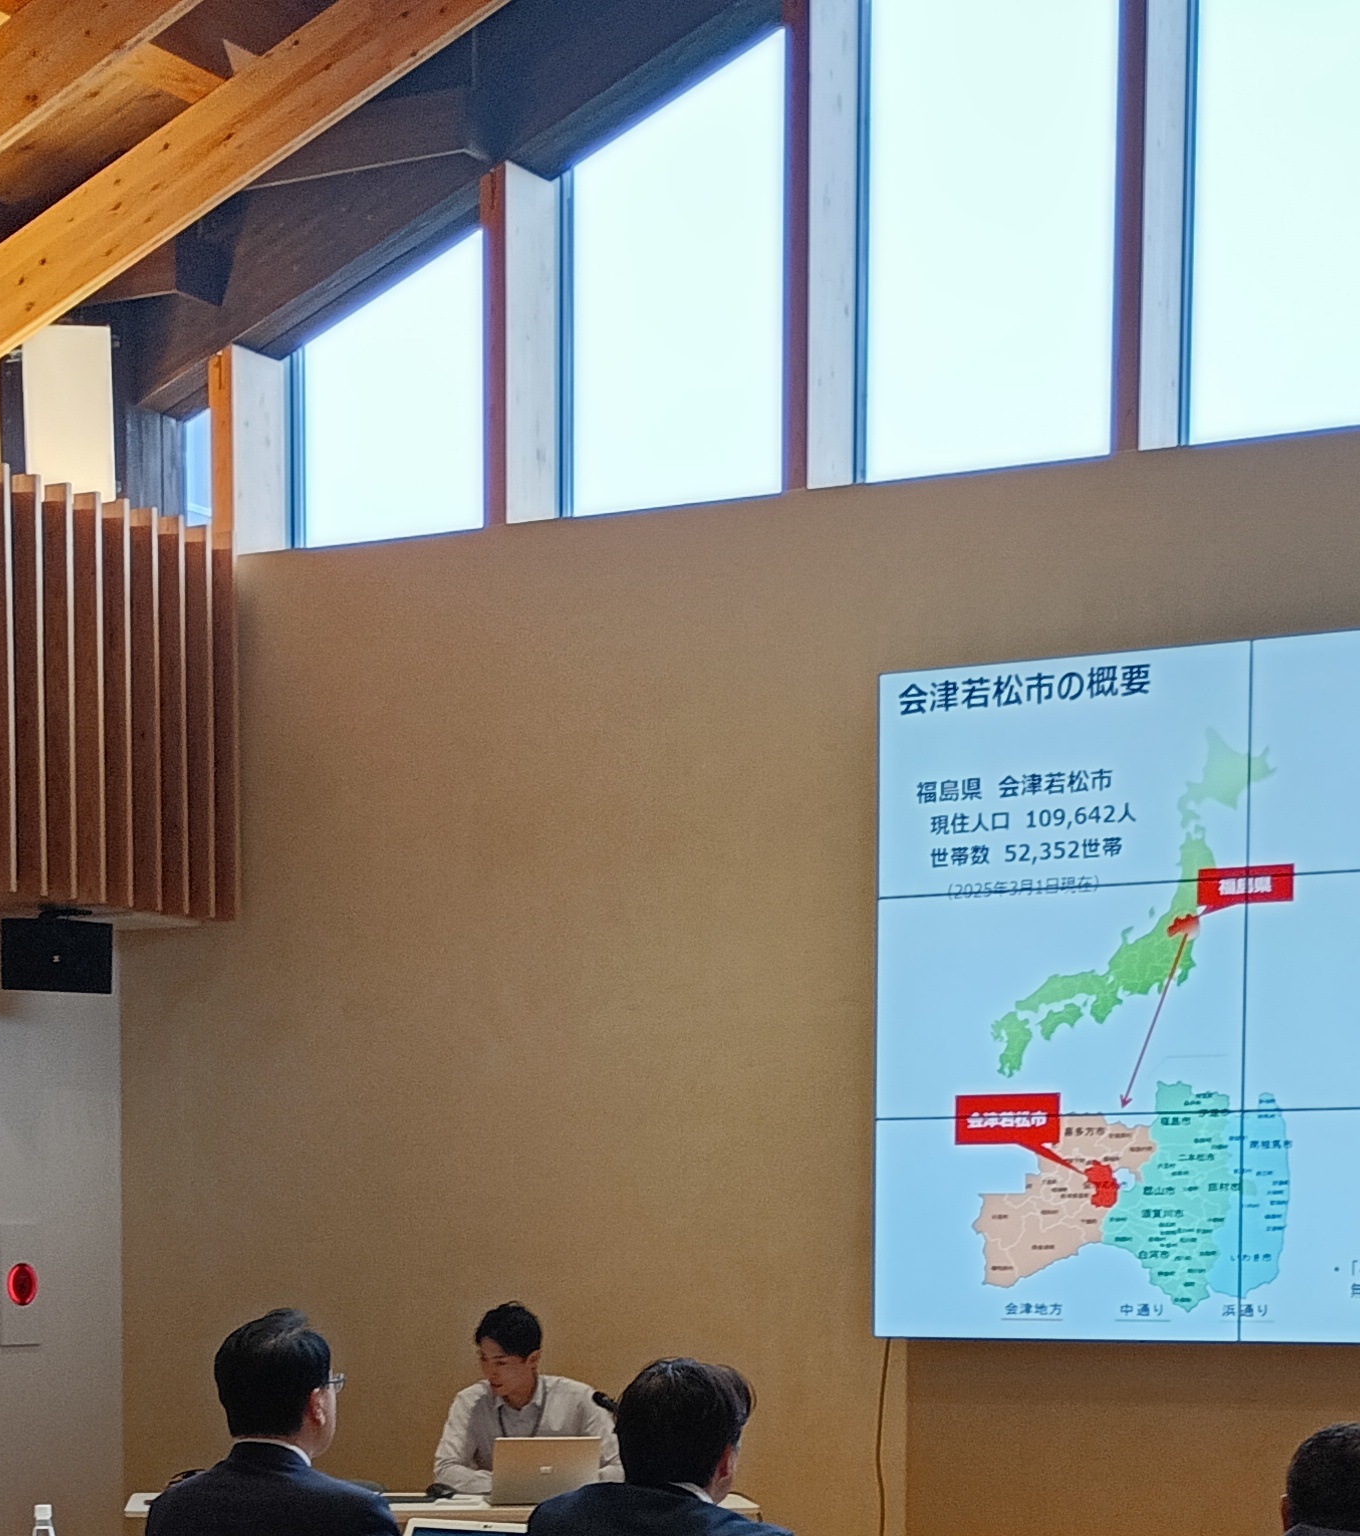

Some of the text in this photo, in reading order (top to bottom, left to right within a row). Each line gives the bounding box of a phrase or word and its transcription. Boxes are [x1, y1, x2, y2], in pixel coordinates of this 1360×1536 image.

[898, 663, 1152, 717] 会津若松市の概要
[916, 768, 1113, 804] 福島県 会津若松市
[930, 803, 1137, 836] 現住人口 109,642人
[930, 837, 1123, 868] 世帯数 52,352世帯
[1005, 1302, 1063, 1317] 会津地方
[1120, 1303, 1165, 1317] 中通り
